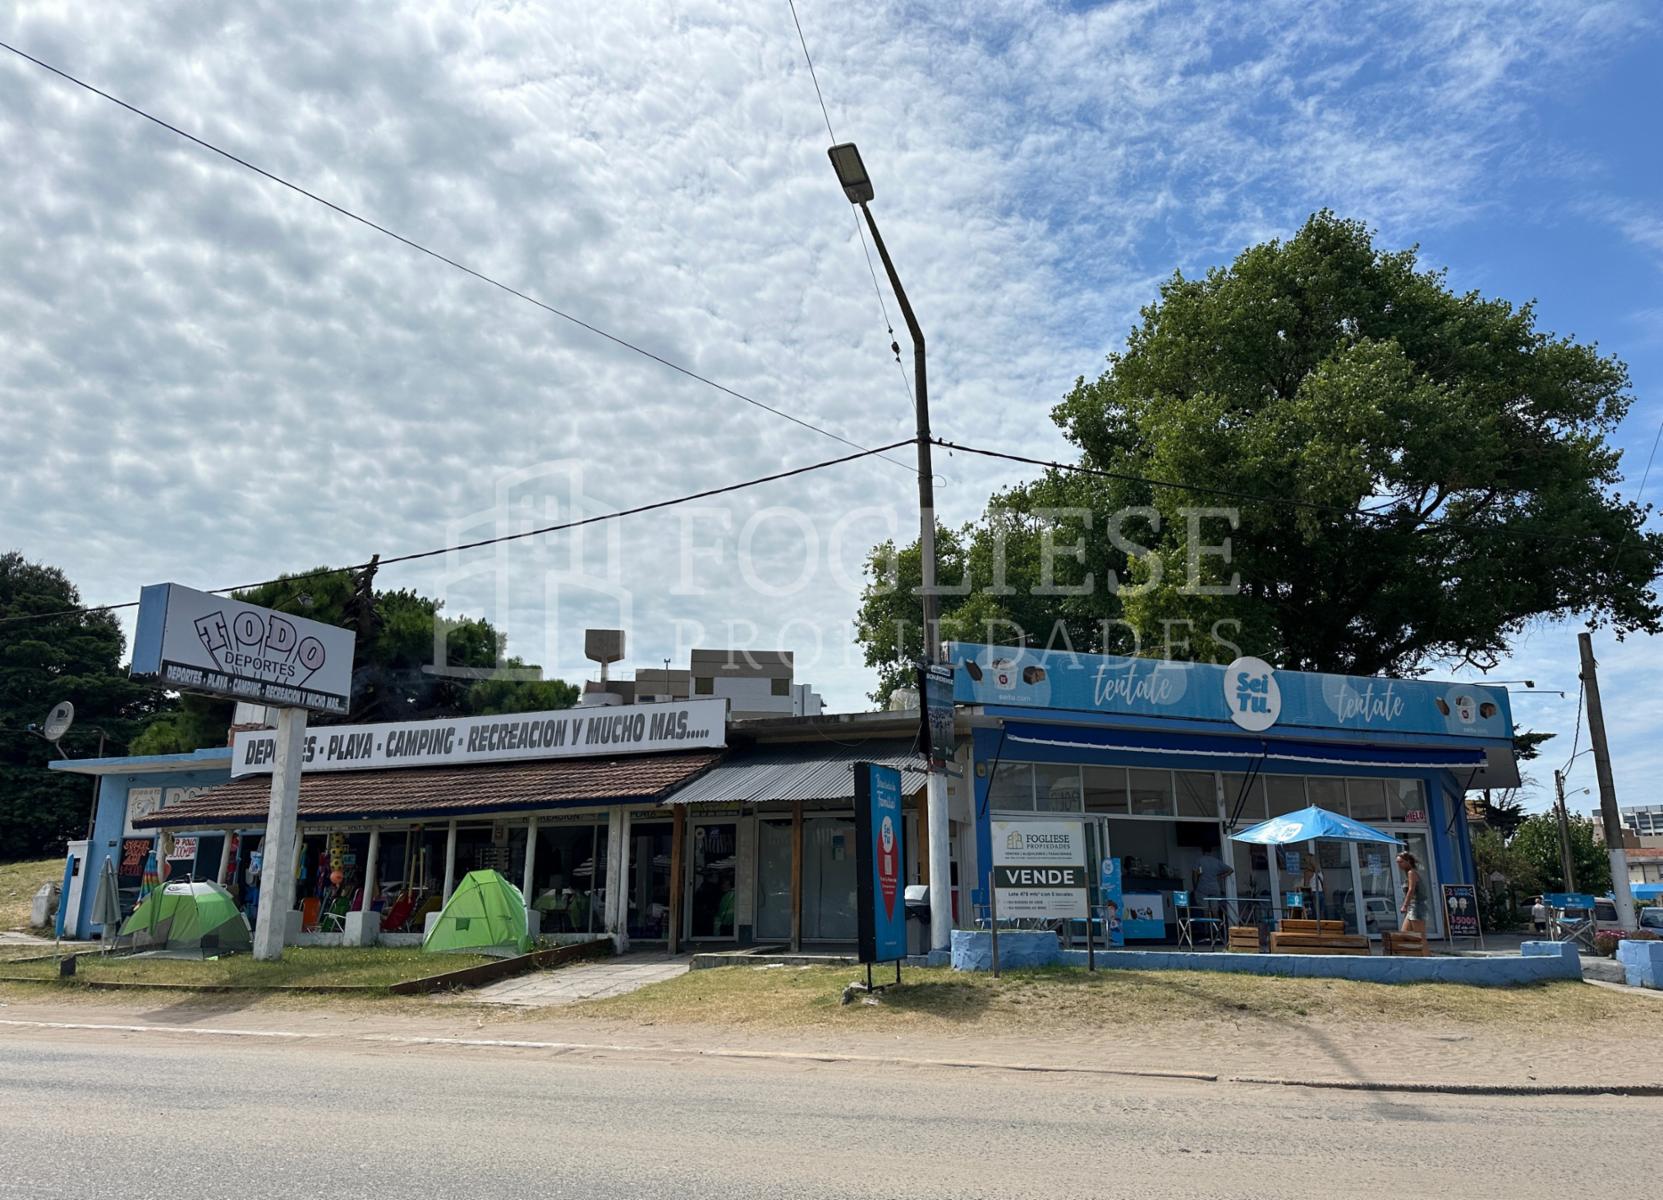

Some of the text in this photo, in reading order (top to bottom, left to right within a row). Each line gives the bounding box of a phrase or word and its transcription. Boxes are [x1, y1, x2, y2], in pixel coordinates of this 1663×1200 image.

[194, 611, 325, 670] TODO
[225, 650, 295, 677] DEPORTES
[1236, 671, 1268, 694] Sei
[167, 665, 202, 684] DEPORTES
[206, 673, 229, 690] PLAYA
[232, 679, 262, 697] CAMPING
[266, 684, 302, 703] RECREACION
[301, 692, 307, 704] Y
[307, 692, 326, 706] MUCHO
[1090, 664, 1172, 706] tentate
[1334, 682, 1405, 724] tentate
[244, 736, 317, 765] DEPS
[327, 732, 374, 760] PLAYA
[385, 727, 455, 758] CAMPING
[467, 720, 567, 752] RECREACION
[571, 718, 584, 746] Y
[585, 713, 645, 744] MUCHO
[1026, 834, 1070, 843] FOGLIESE
[1006, 869, 1075, 885] VENDE
